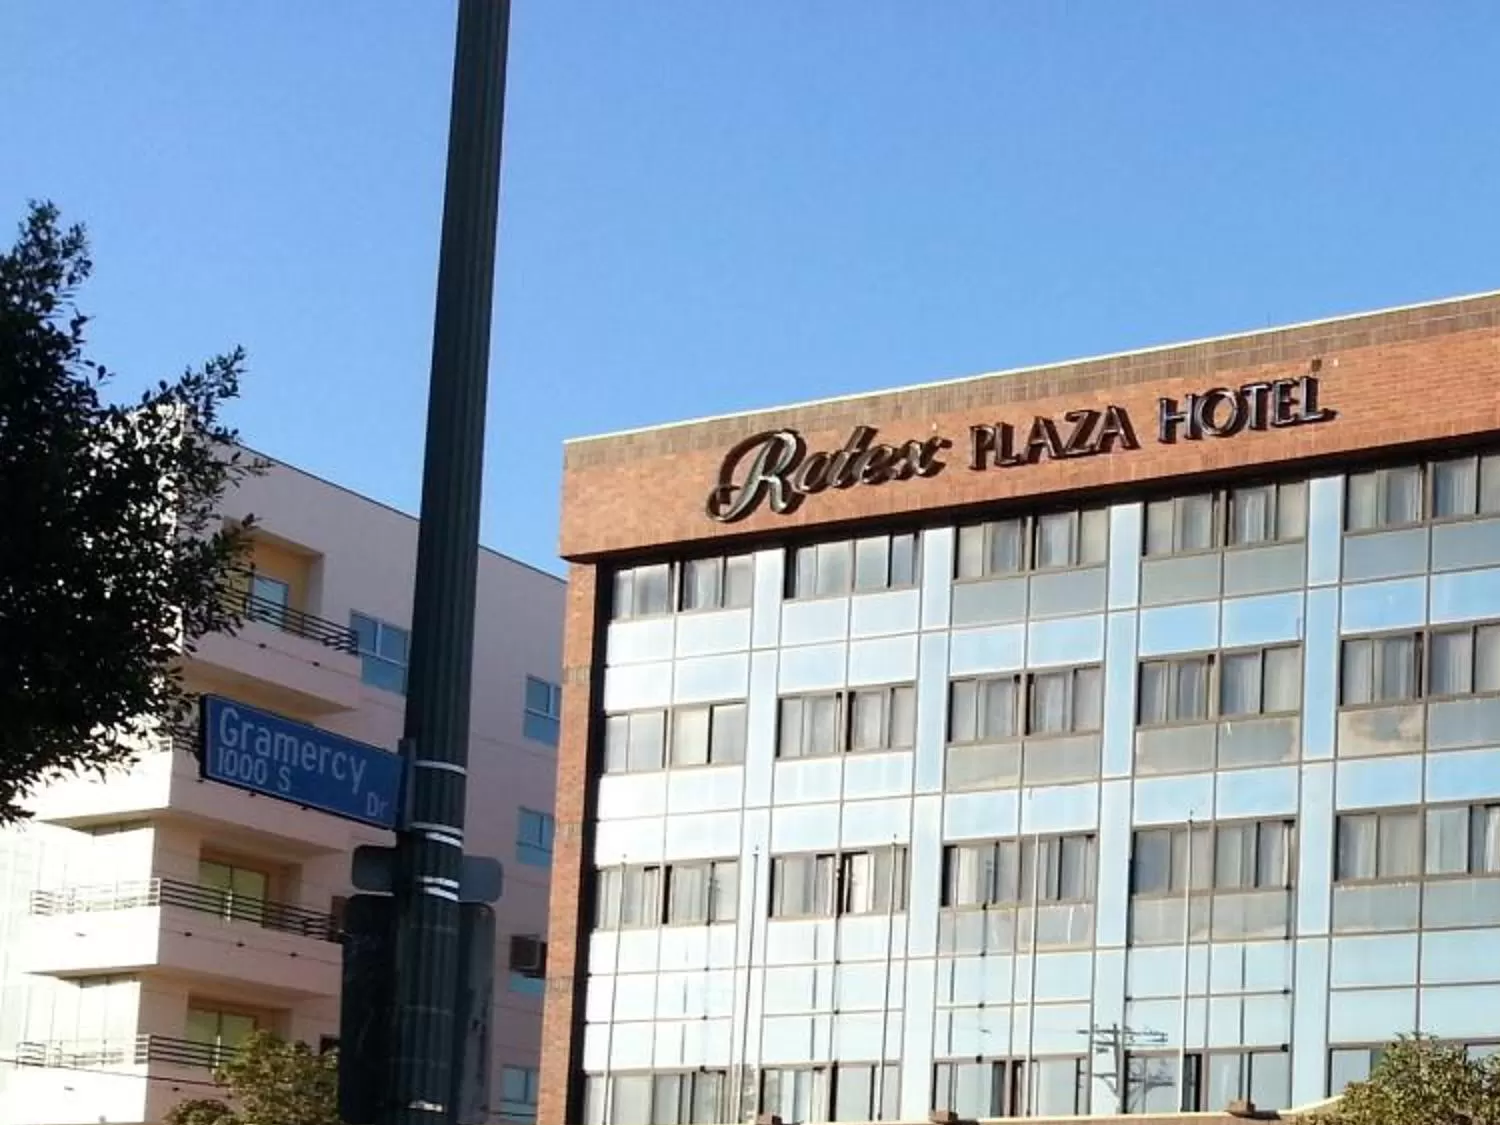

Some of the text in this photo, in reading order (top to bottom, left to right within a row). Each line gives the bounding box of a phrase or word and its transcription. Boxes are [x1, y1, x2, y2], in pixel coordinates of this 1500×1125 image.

[706, 375, 1338, 523] Rotex PLAZA HOTEL
[217, 747, 292, 793] 1000 S
[219, 707, 388, 817] Gramercy Dr
